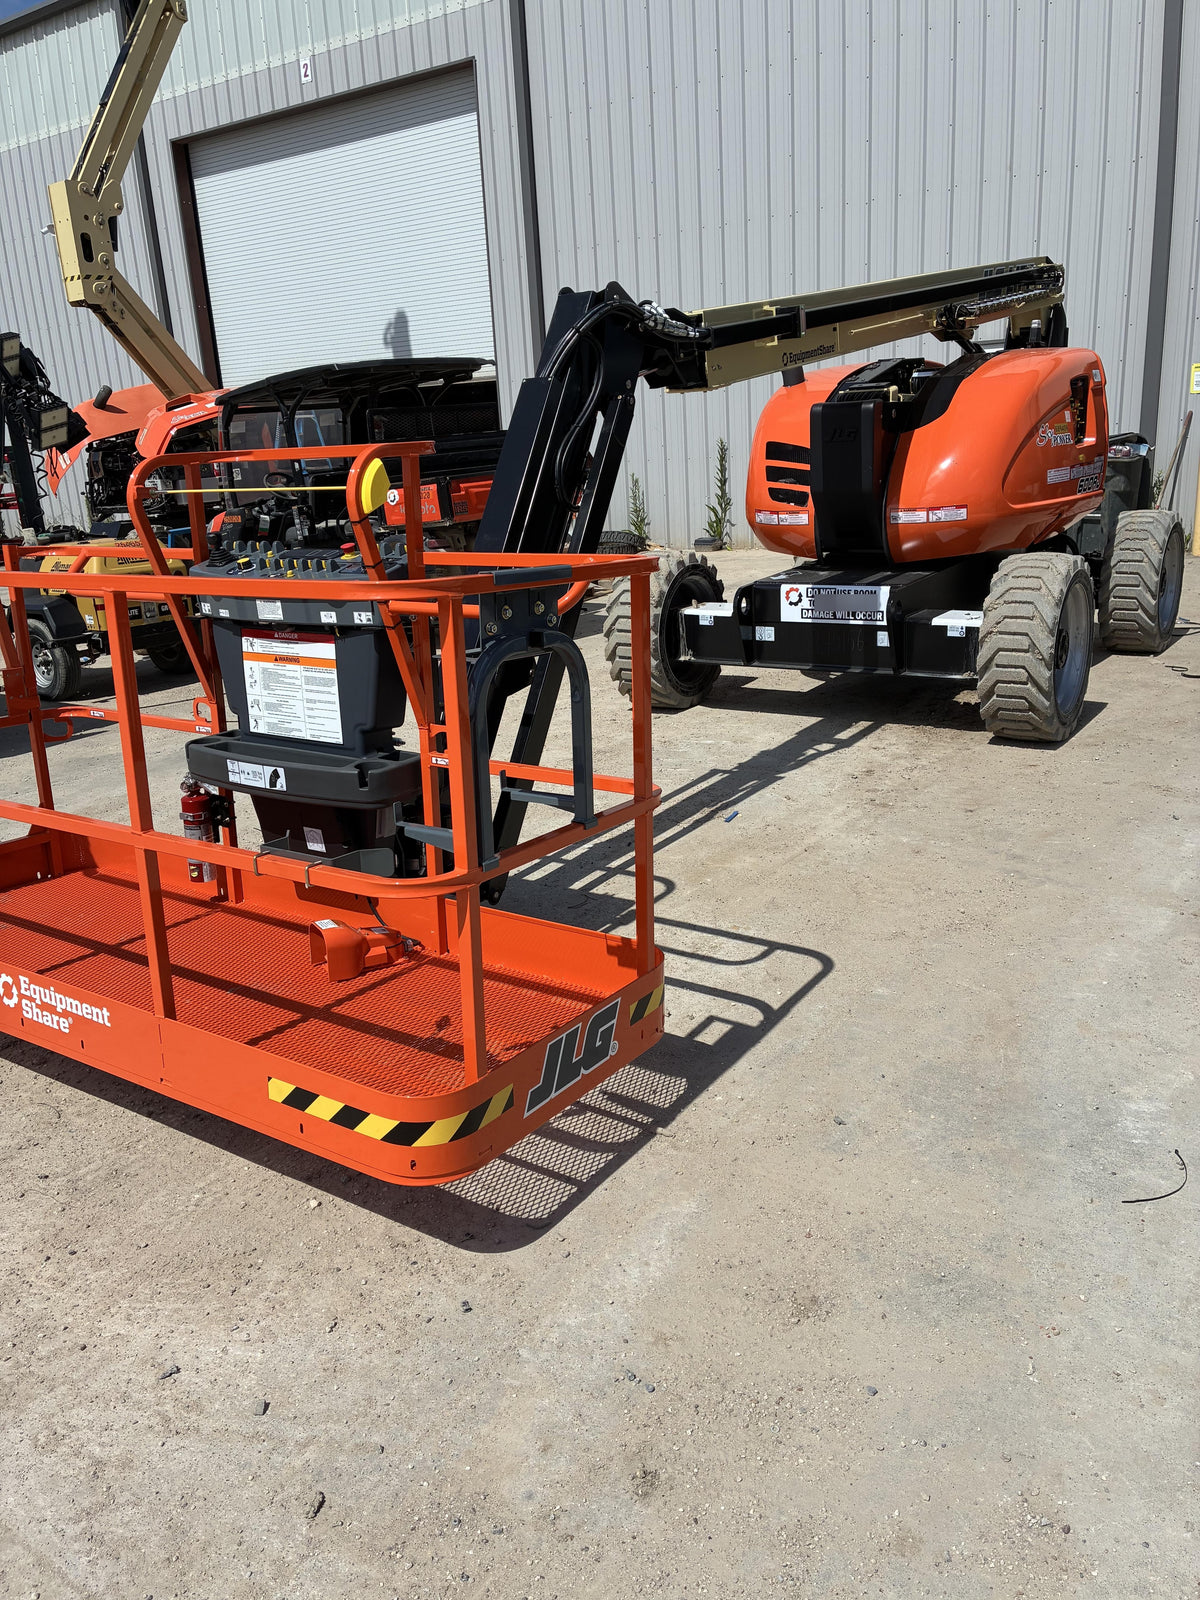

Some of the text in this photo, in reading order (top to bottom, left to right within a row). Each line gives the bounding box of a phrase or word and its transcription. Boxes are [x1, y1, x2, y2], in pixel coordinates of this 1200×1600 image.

[302, 62, 310, 78] 2
[788, 344, 835, 365] EquipmentShare
[802, 609, 883, 620] DAMAGE WILL OCCUR
[278, 656, 300, 664] WARNING
[19, 975, 111, 1027] Equipment
